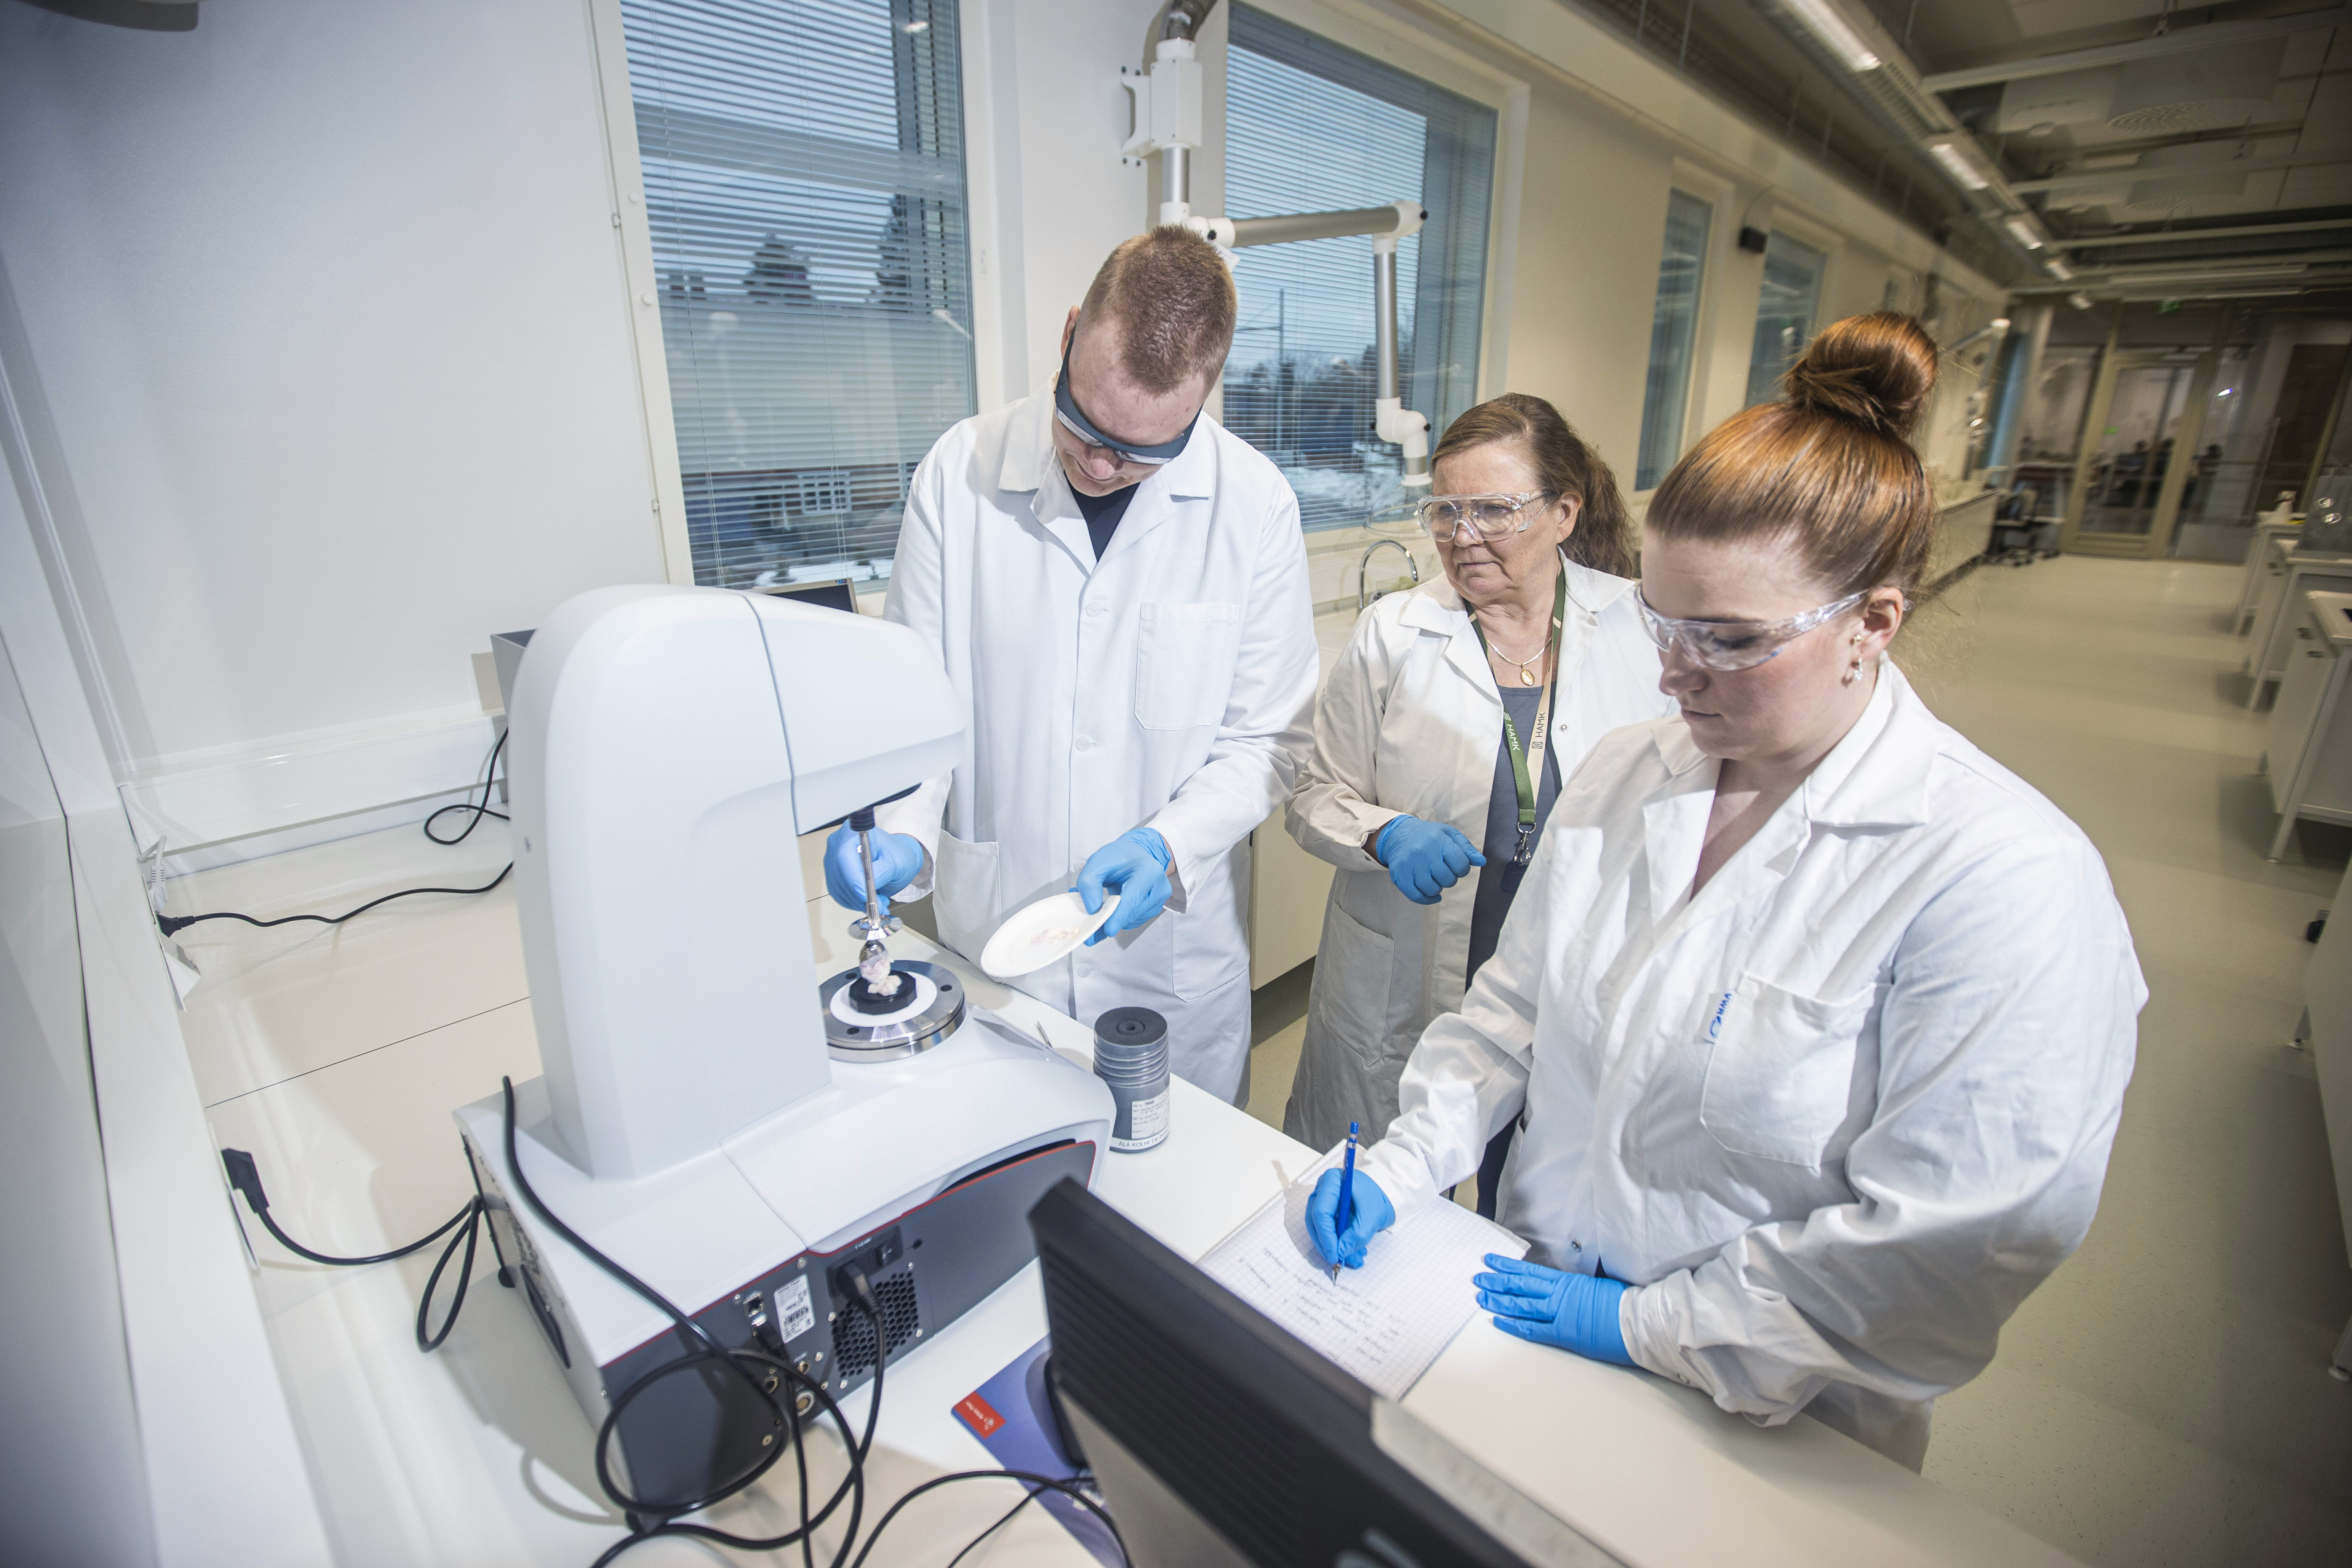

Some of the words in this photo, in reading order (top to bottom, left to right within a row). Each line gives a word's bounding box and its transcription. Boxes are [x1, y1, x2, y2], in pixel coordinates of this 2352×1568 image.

[1507, 724, 1520, 750] HAMK
[1535, 712, 1546, 738] HAMK
[1717, 994, 1732, 1015] VWR
